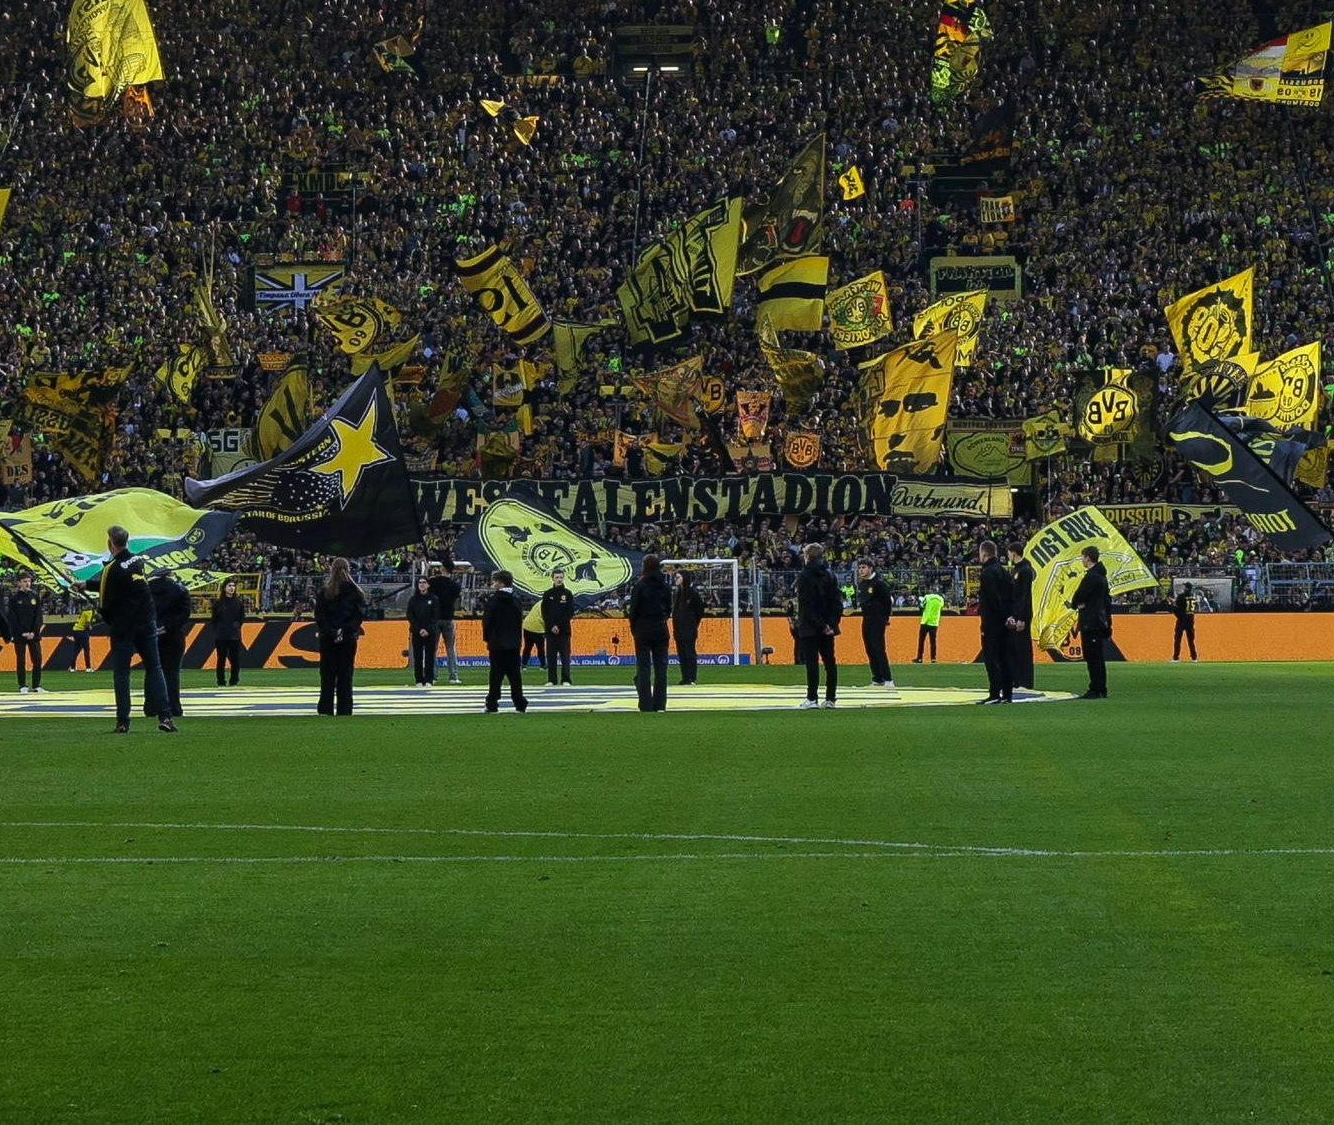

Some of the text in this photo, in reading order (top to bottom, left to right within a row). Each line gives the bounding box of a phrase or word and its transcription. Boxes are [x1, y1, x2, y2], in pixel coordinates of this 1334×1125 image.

[791, 439, 813, 456] BVB
[411, 474, 986, 525] WESFALENSTADION Dortmund
